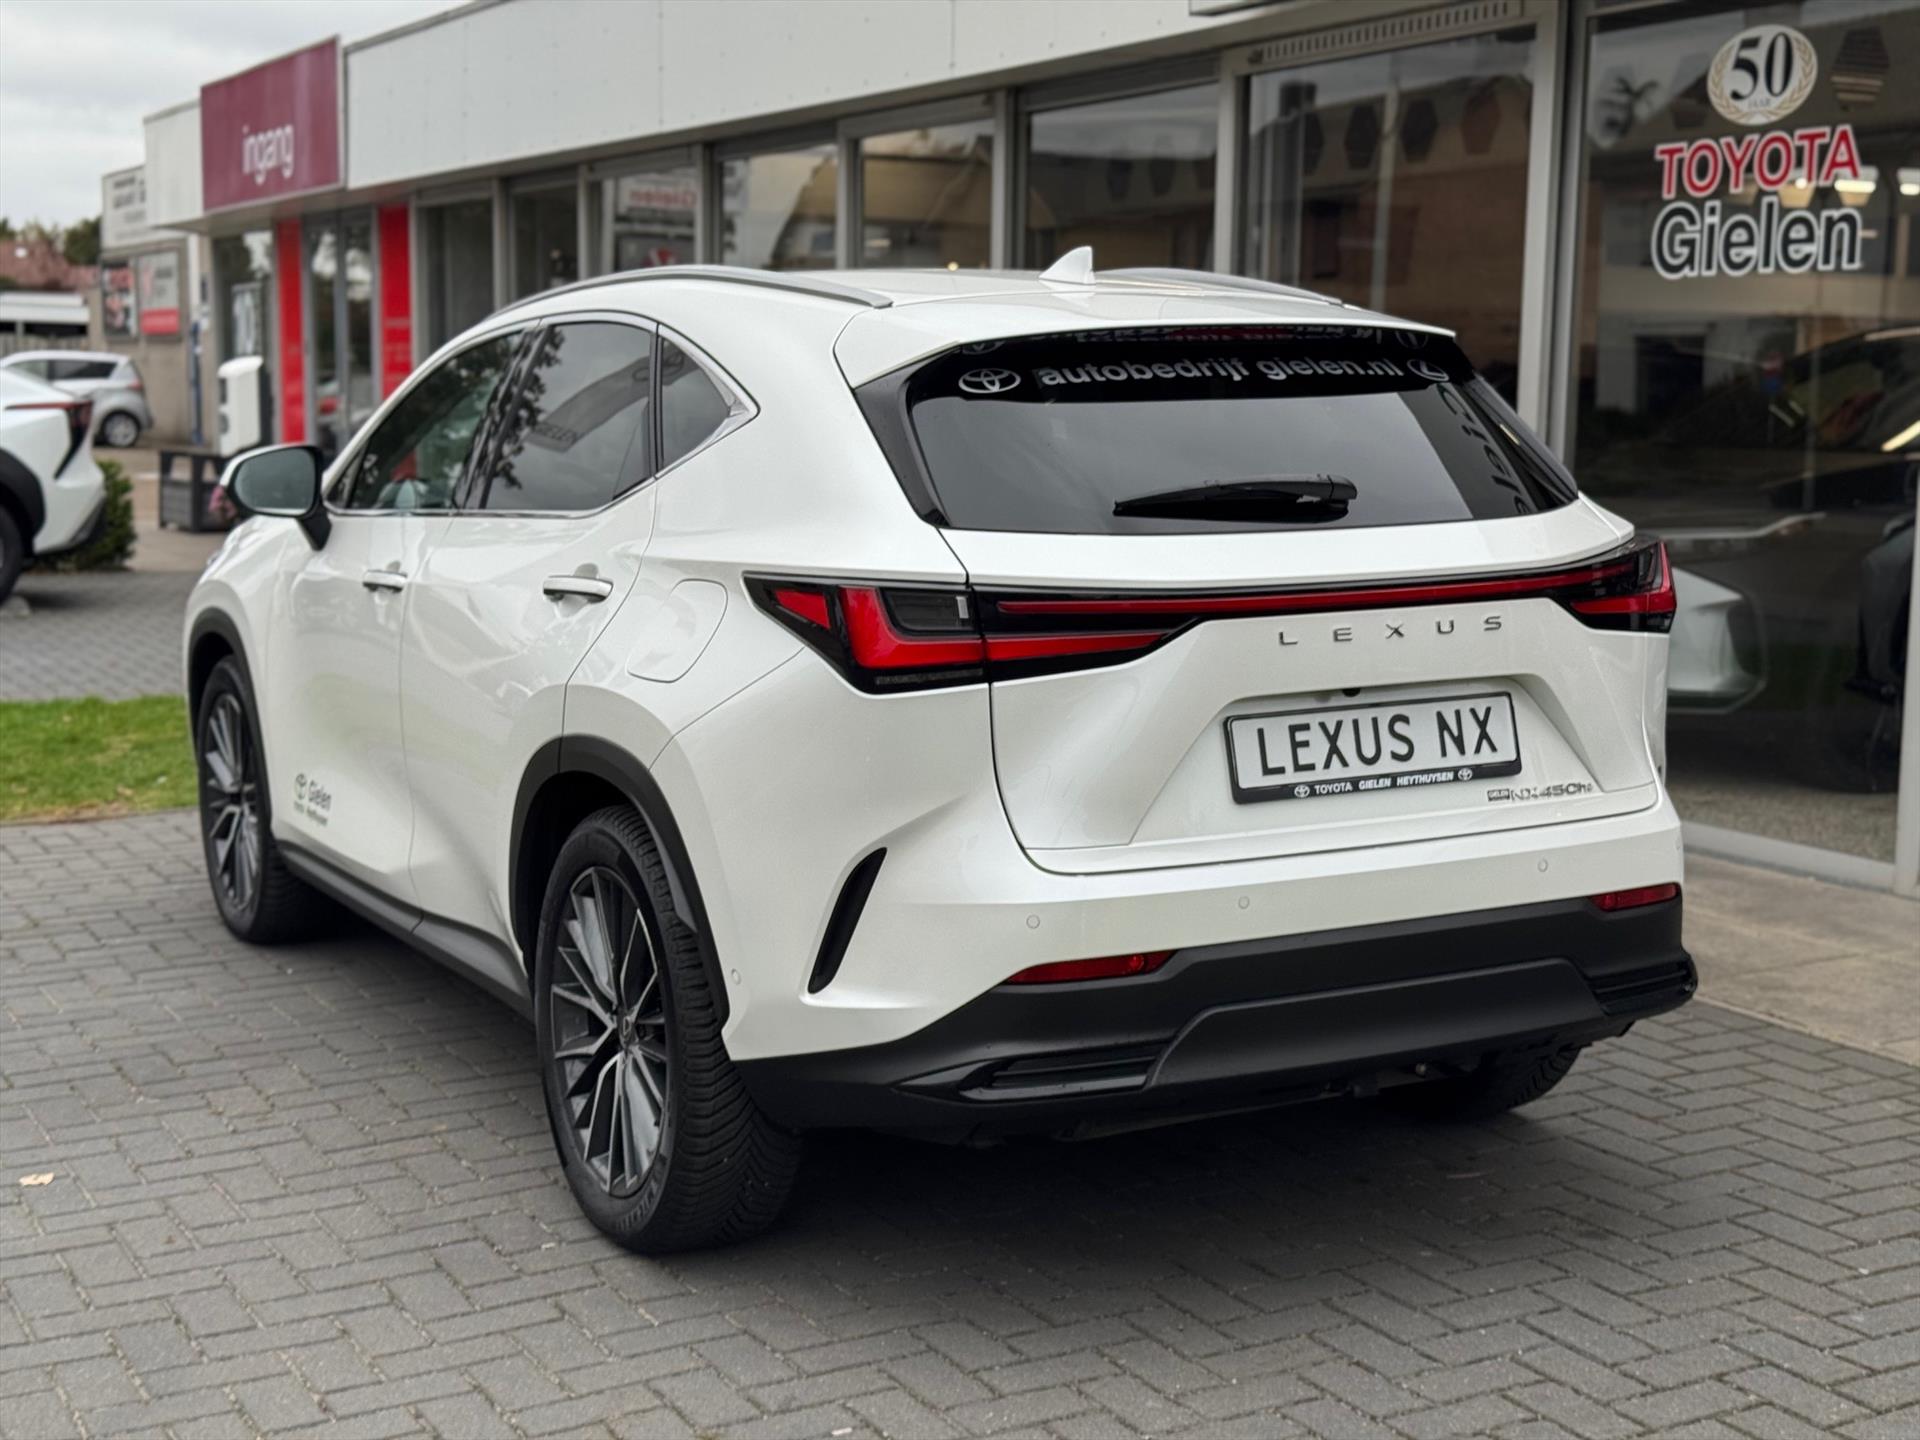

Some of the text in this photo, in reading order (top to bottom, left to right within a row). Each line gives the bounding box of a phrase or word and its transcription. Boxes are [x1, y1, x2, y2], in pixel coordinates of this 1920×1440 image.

[1730, 32, 1793, 101] 50
[242, 124, 294, 185] ingang
[1655, 124, 1861, 199] TOYOTA
[1651, 197, 1863, 280] Gielen
[1038, 357, 1404, 386] autobedrijf gielen.nl
[1279, 616, 1502, 646] LEXUS
[1257, 706, 1498, 777] LEXUS NX
[1314, 771, 1453, 795] TOYOTA GIELEN HEYTHUYSEN
